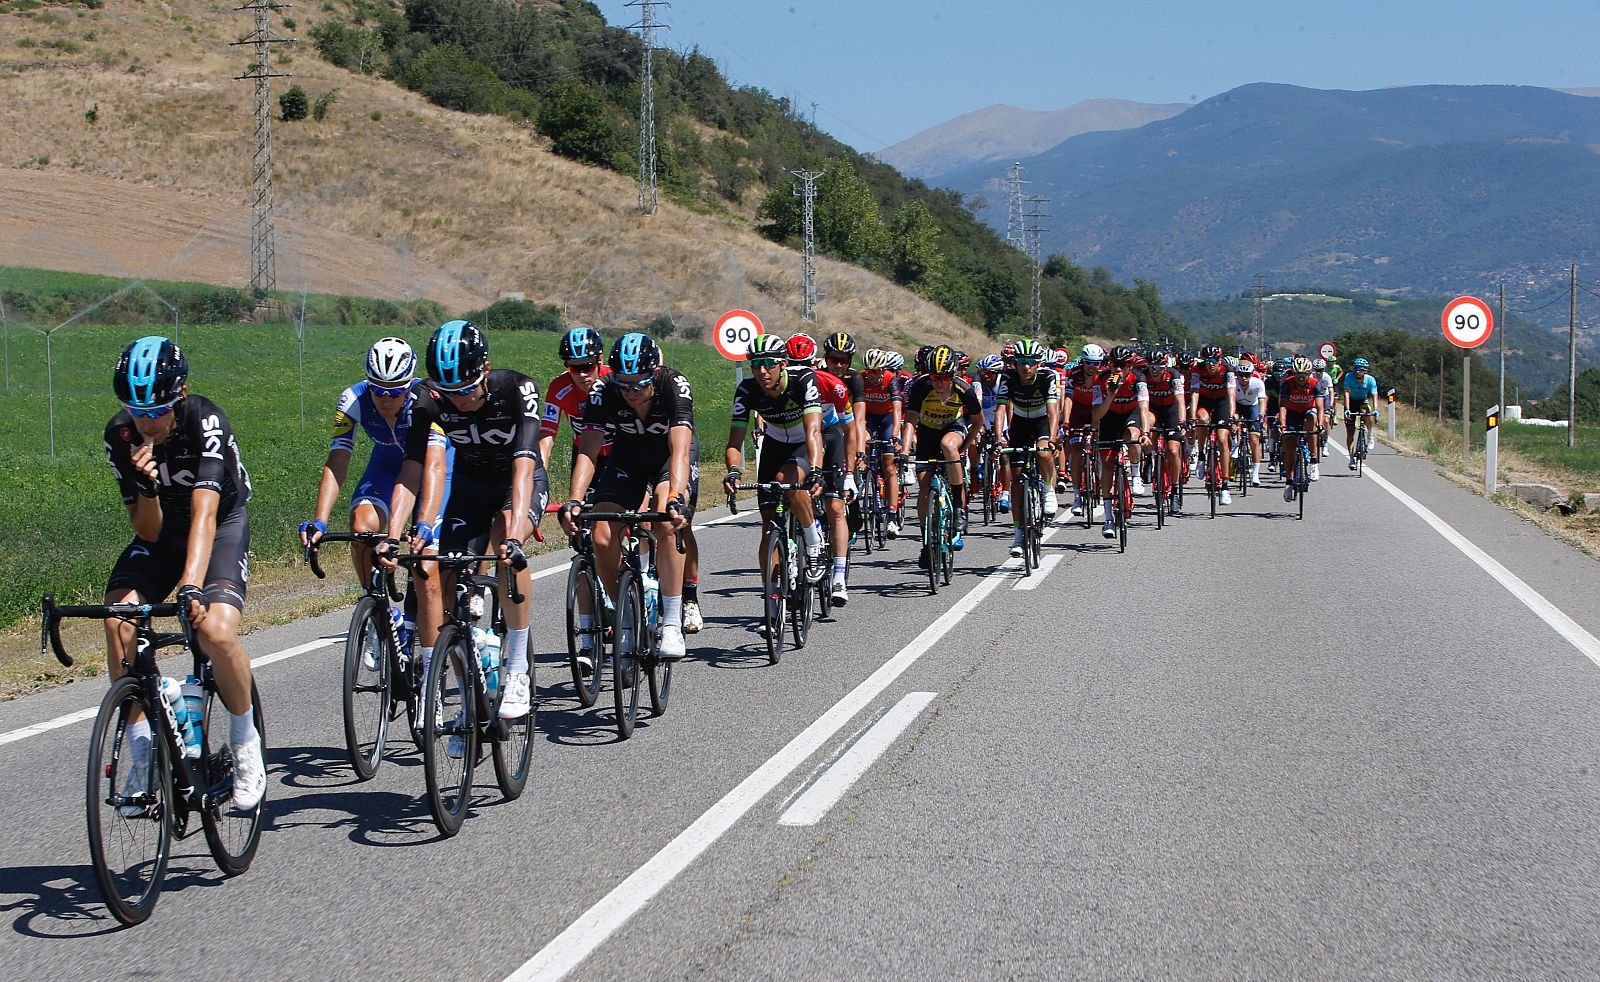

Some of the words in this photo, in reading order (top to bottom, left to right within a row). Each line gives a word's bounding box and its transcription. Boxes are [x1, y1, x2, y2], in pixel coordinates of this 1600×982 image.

[1455, 314, 1479, 330] 90
[726, 327, 750, 344] 90
[864, 391, 891, 399] AHRAIN
